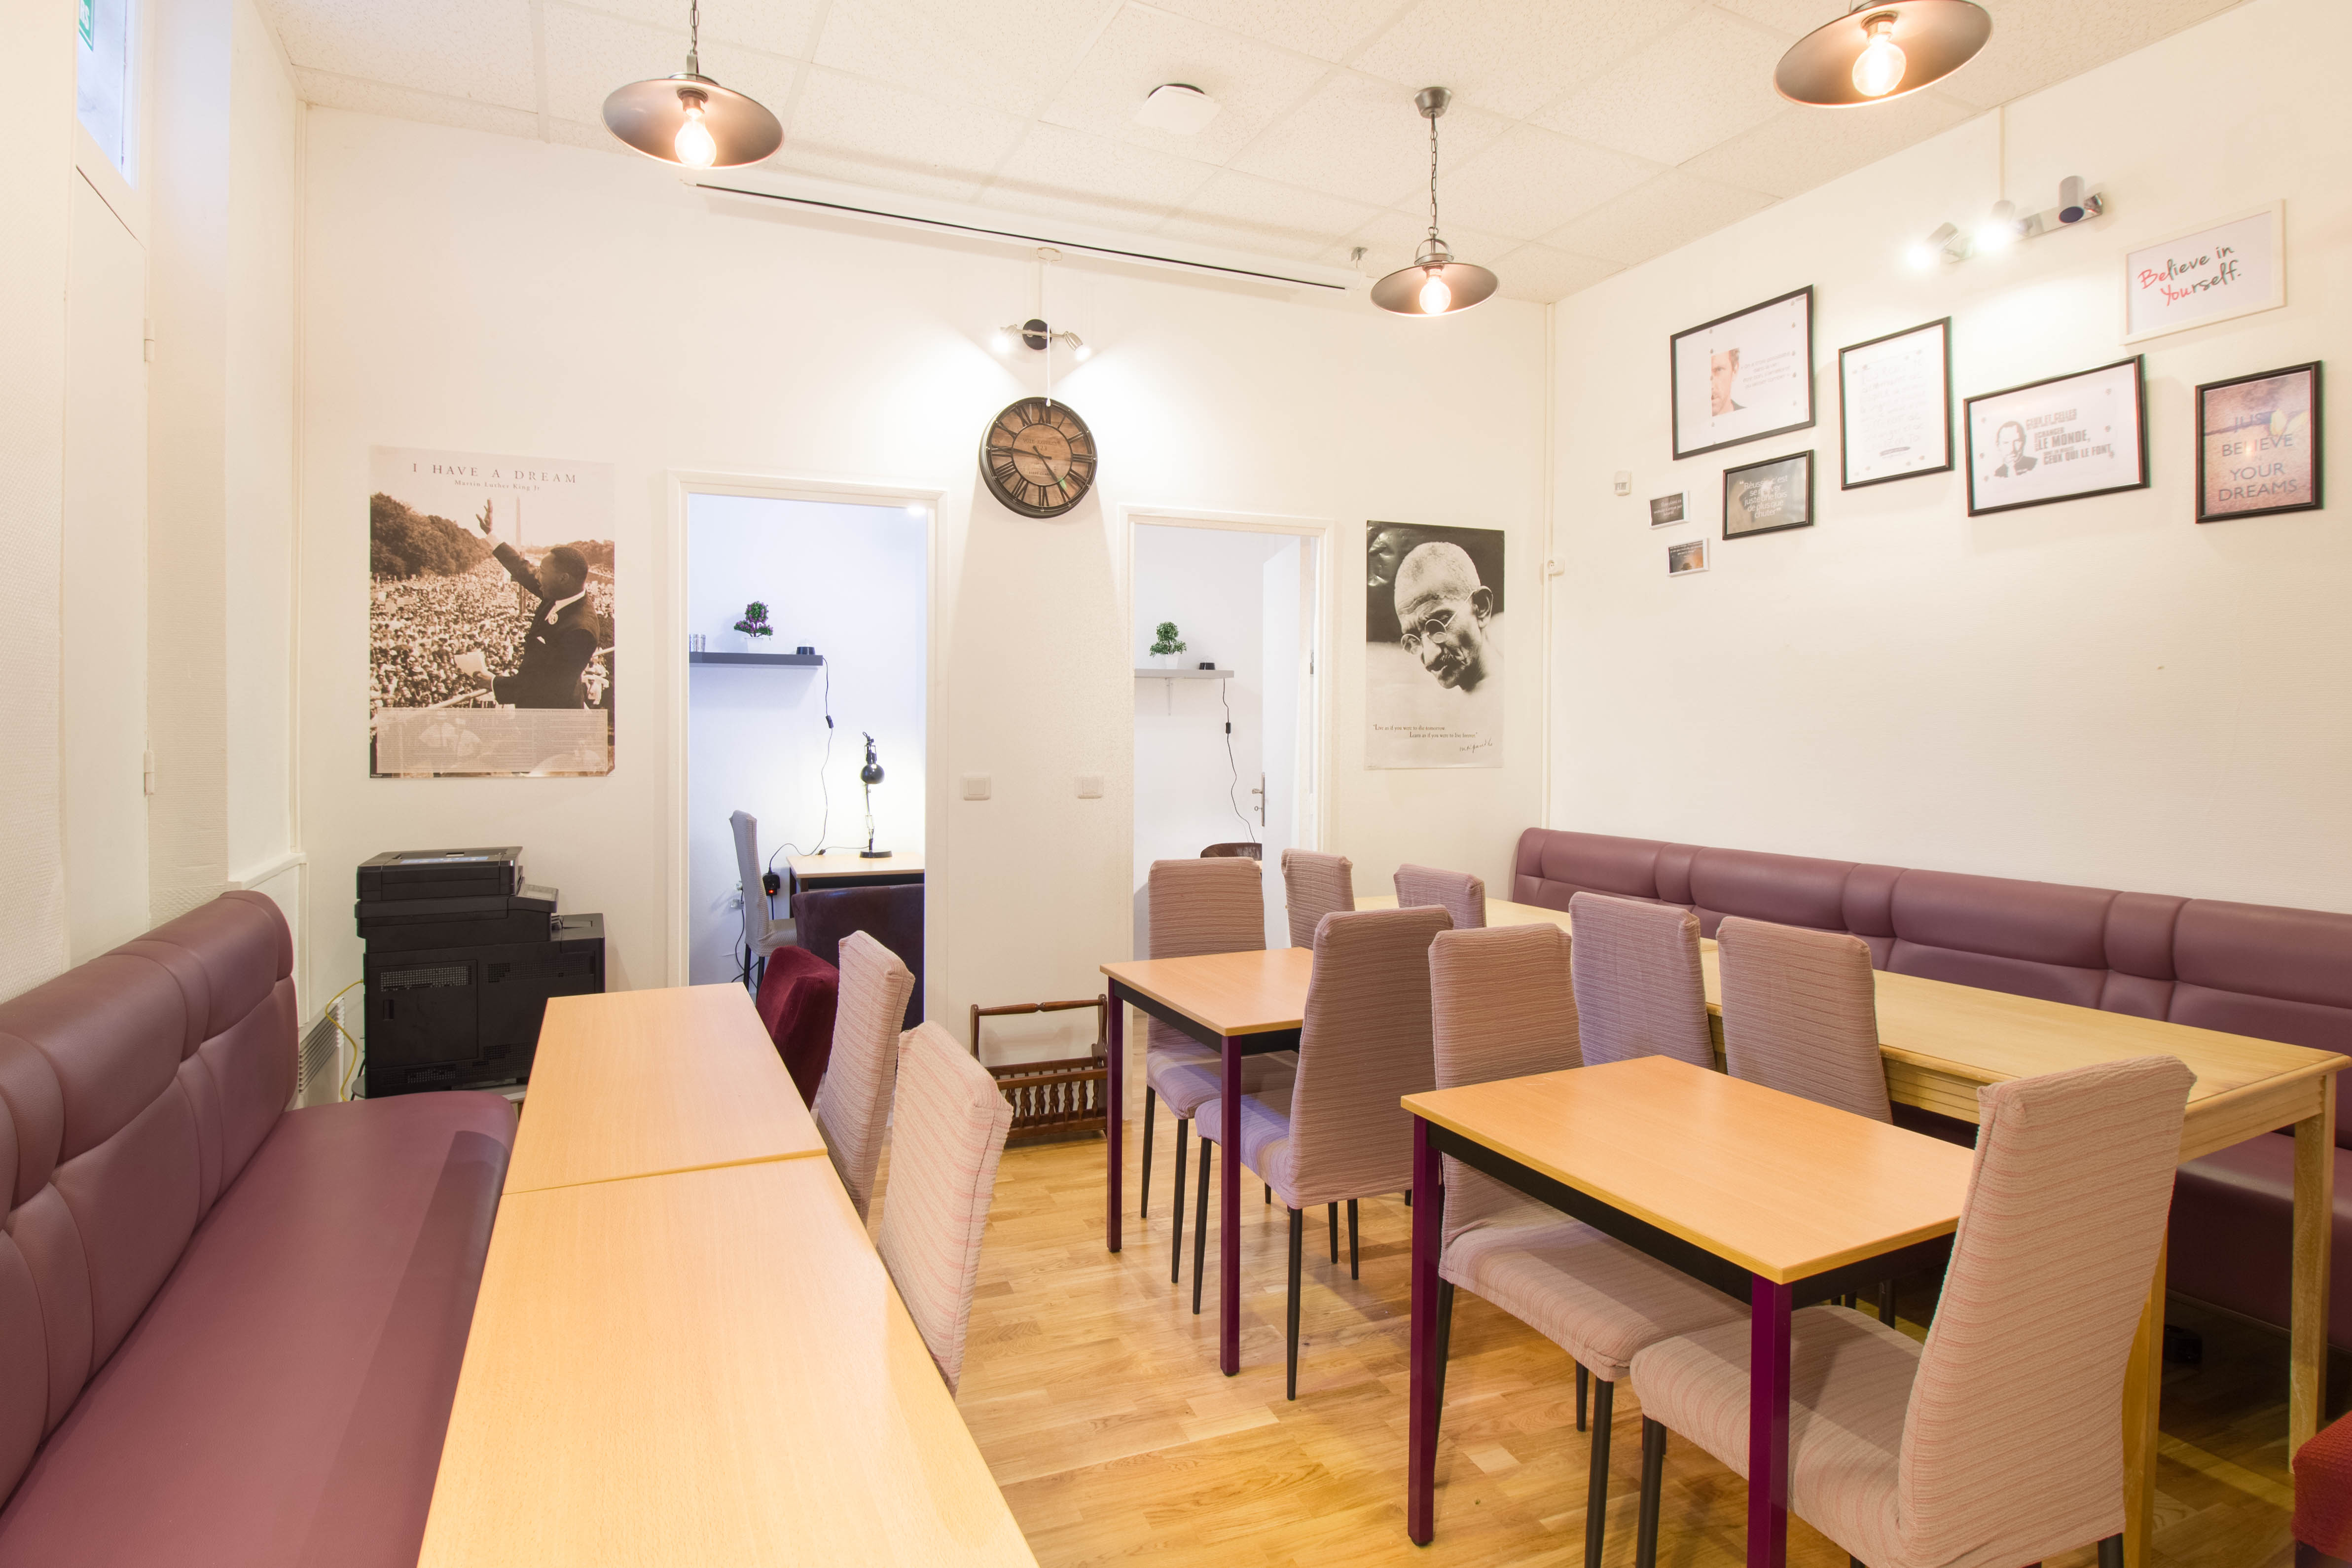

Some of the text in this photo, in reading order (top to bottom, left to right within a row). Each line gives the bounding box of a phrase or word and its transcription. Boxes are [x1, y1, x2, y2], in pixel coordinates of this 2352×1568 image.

[2137, 246, 2234, 289] Believe in
[2160, 259, 2241, 306] Yourself.
[2038, 438, 2048, 450] LE
[2052, 430, 2090, 447] MONDE,
[2065, 450, 2078, 461] QUI
[2081, 448, 2089, 458] LE
[413, 463, 576, 483] I HAVE A DREAM
[2230, 462, 2285, 481] YOUR
[2219, 479, 2297, 502] DREAMS
[1744, 496, 1760, 506] juste
[1756, 502, 1770, 512] plus
[1771, 500, 1783, 510] que
